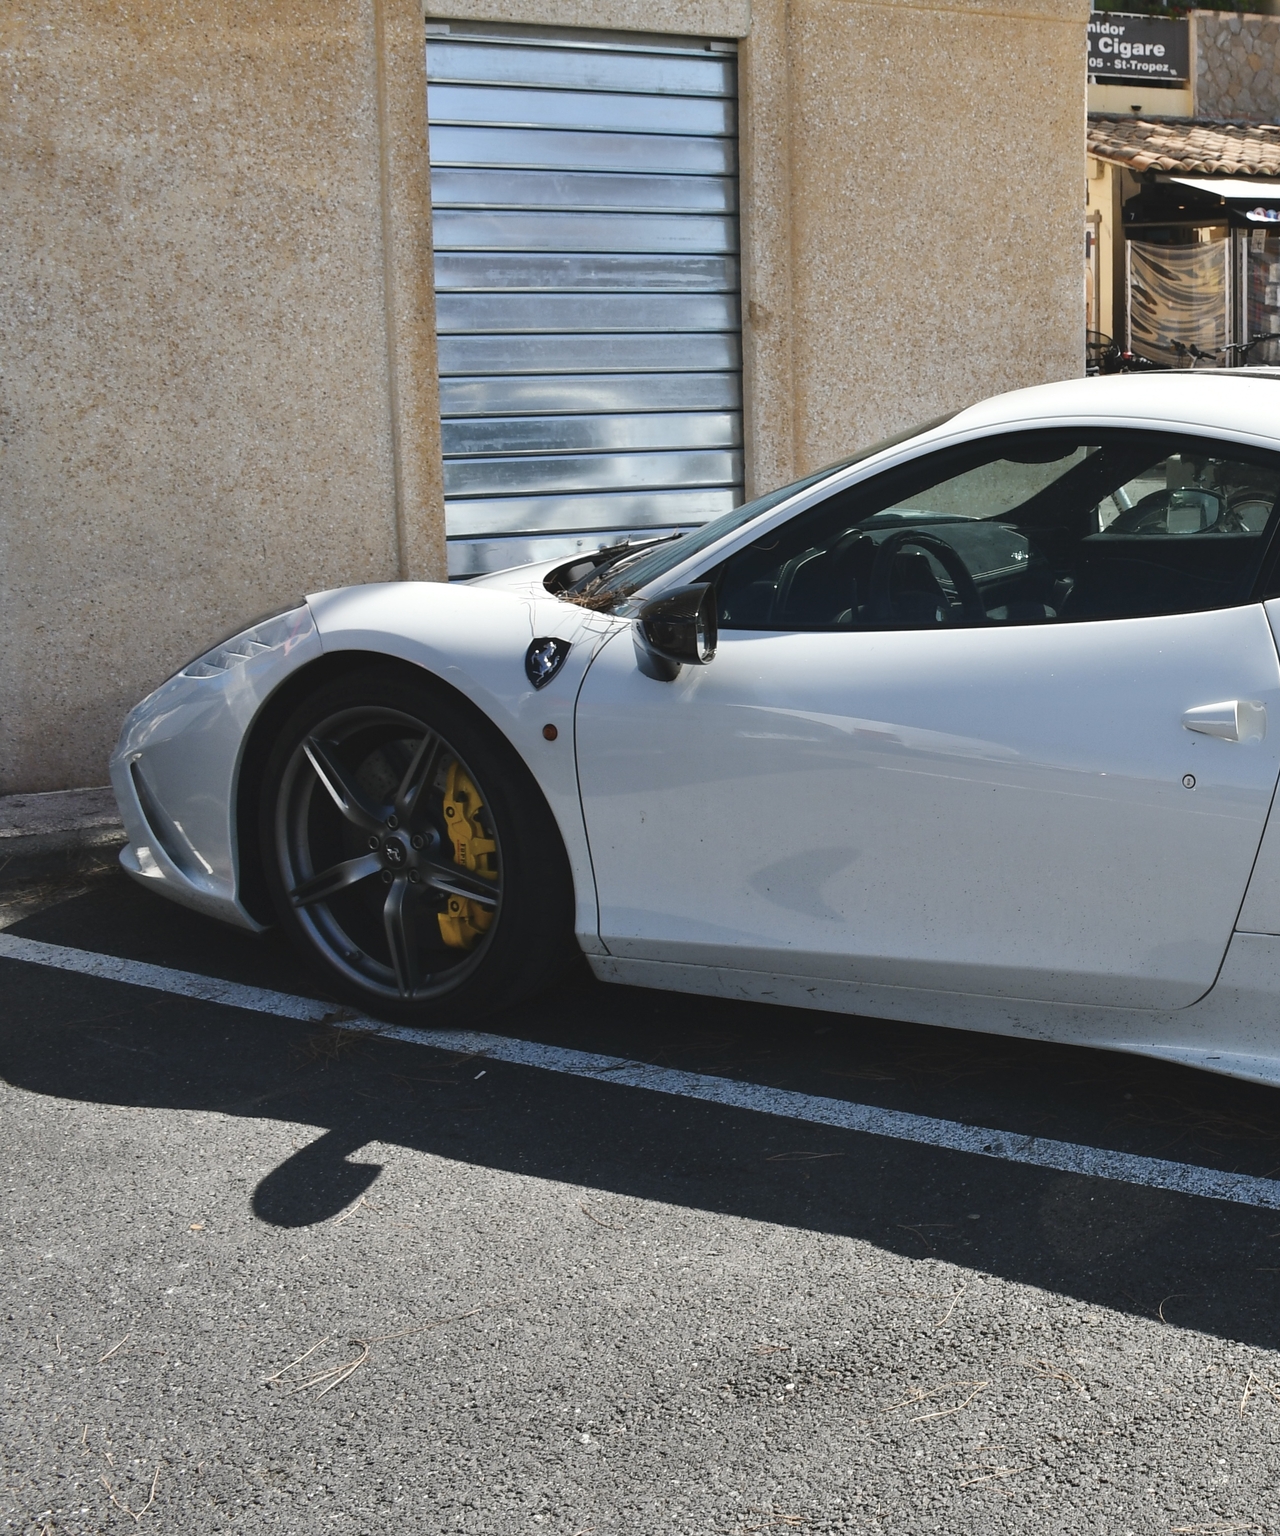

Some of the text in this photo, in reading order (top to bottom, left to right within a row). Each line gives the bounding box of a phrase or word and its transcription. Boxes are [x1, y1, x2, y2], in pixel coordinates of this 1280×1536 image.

[1098, 36, 1165, 59] Cigare
[1089, 57, 1169, 73] 05 St-Tropez
